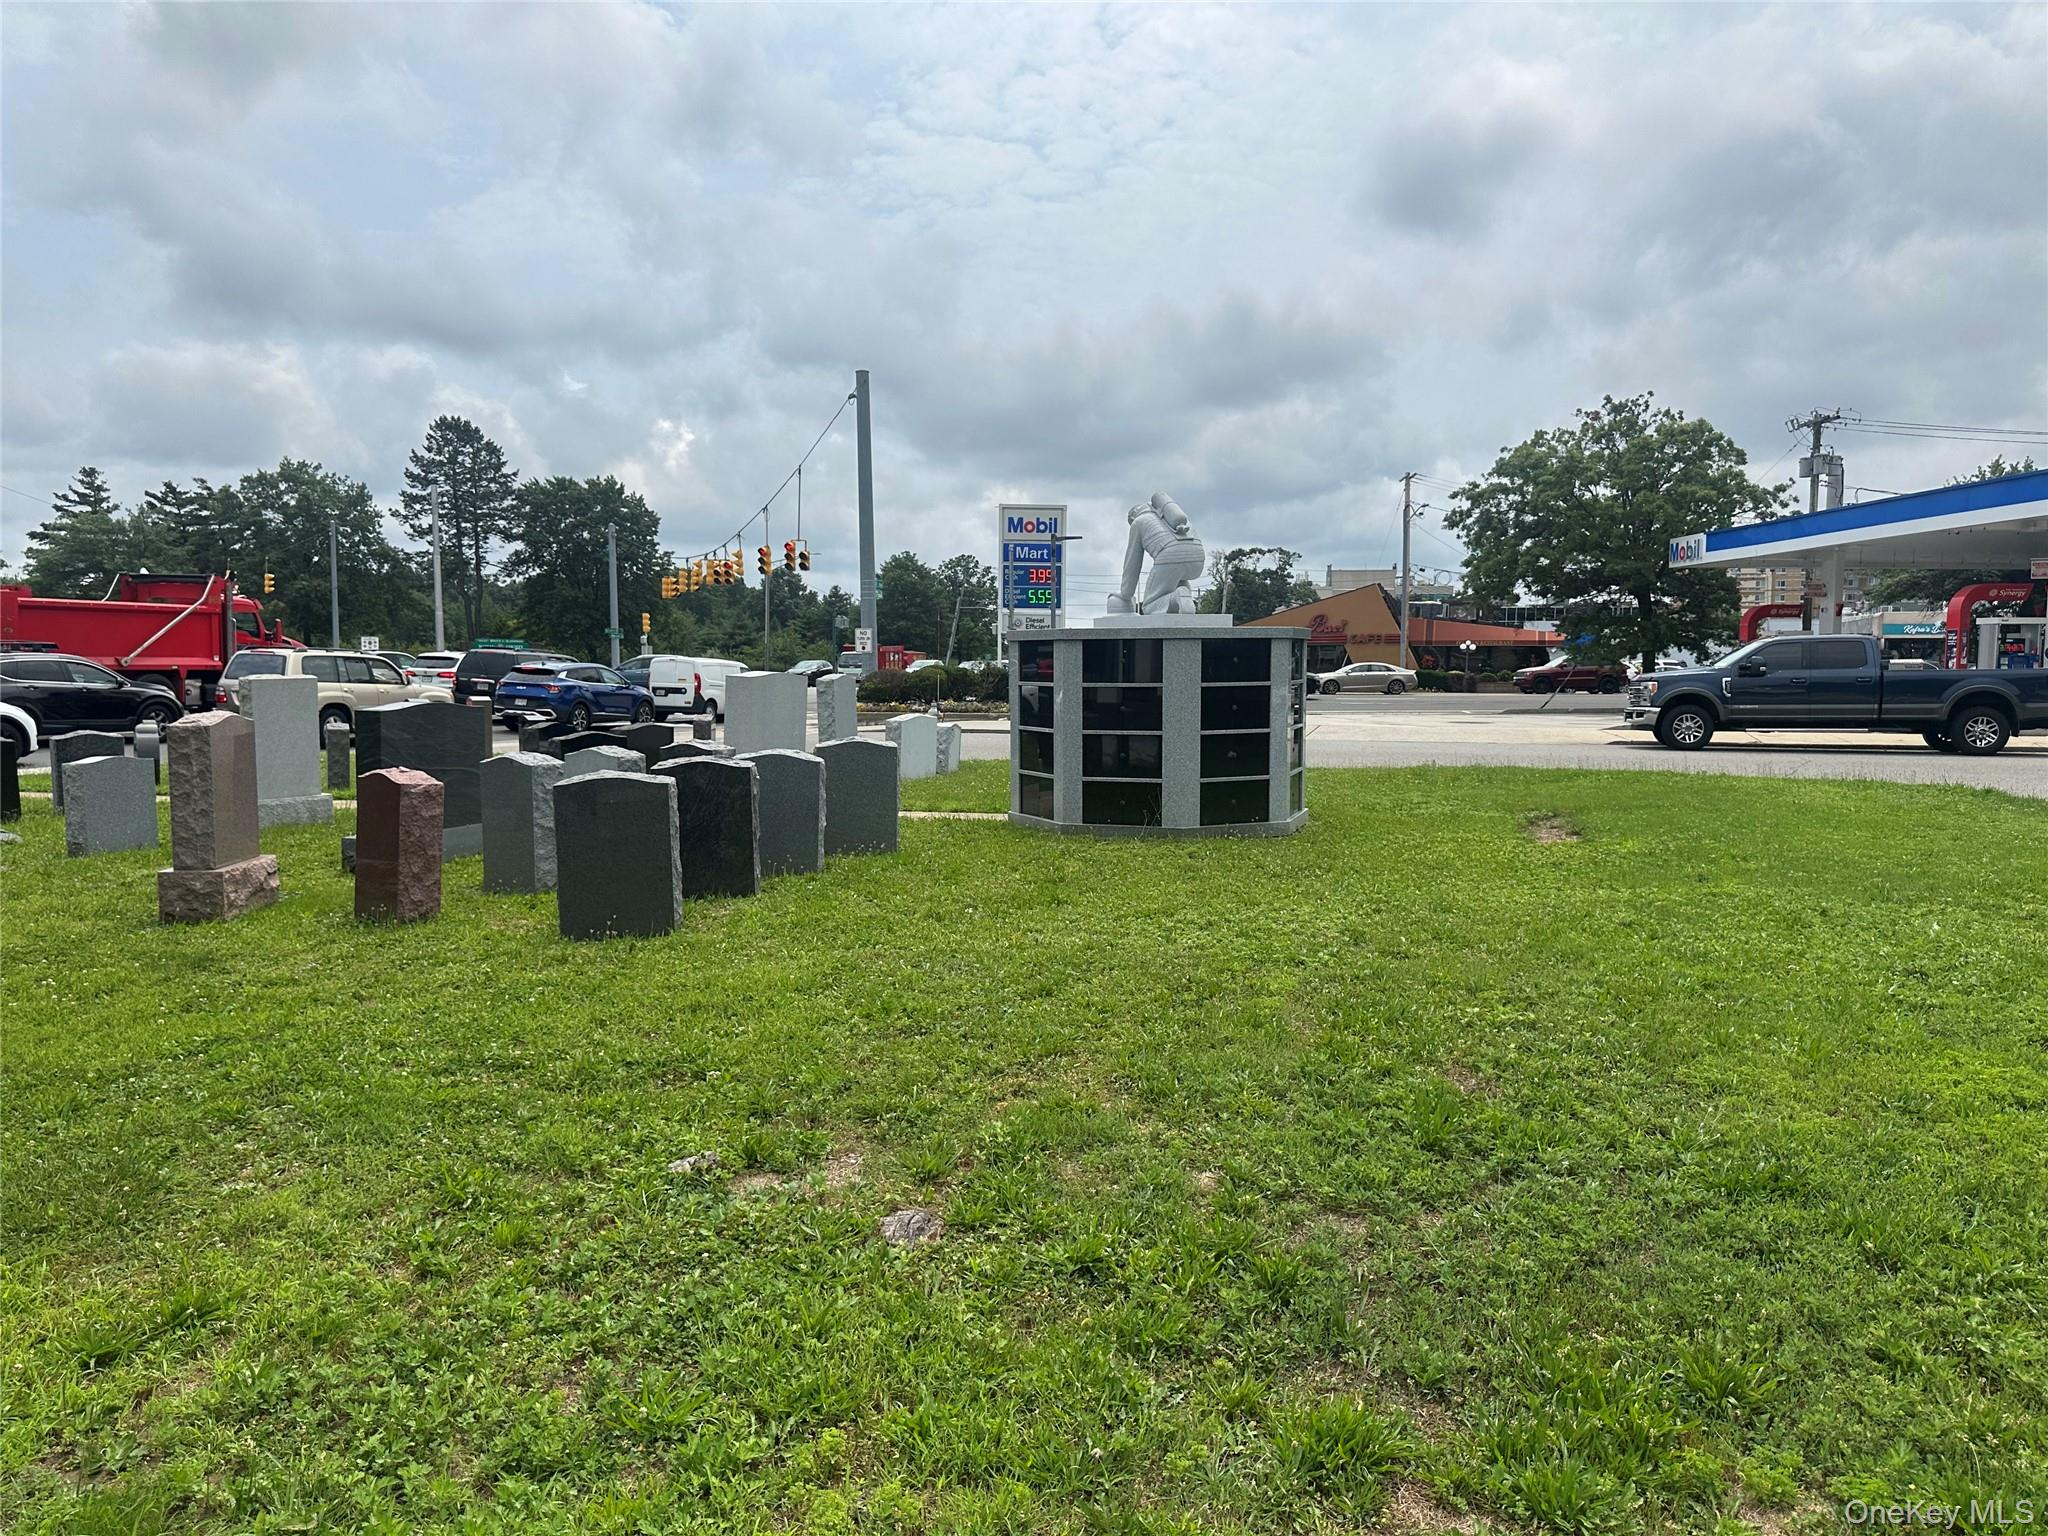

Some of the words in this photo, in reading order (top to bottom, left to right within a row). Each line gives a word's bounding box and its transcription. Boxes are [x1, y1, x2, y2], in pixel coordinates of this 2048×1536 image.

[1008, 517, 1057, 533] Mobil
[1016, 547, 1048, 559] Mart
[1670, 538, 1700, 561] Mobil
[1999, 590, 2026, 598] Synergy
